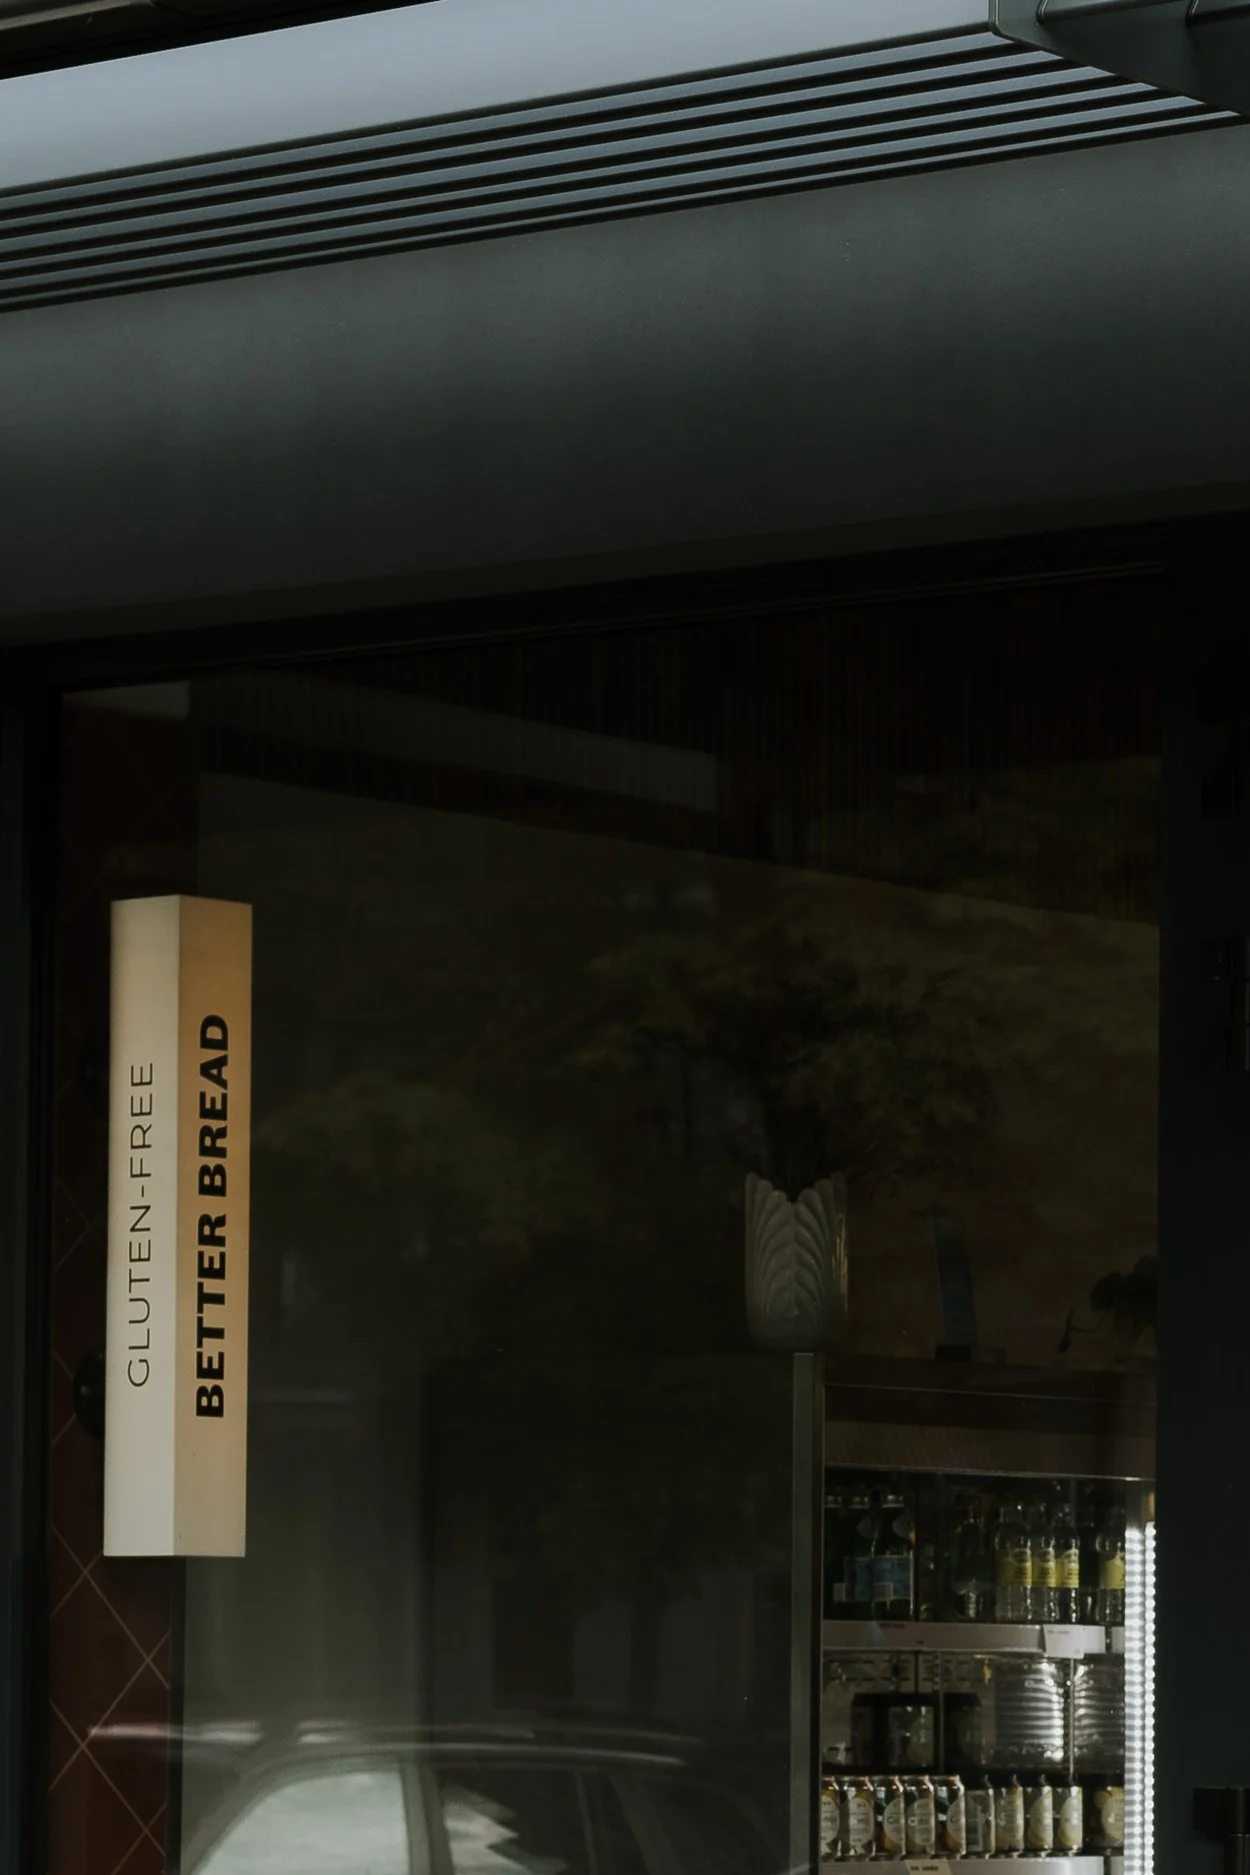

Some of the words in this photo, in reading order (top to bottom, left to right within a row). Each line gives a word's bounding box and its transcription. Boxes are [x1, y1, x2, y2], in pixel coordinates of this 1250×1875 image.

[198, 1013, 230, 1198] BREAD
[127, 1061, 153, 1388] GLUTEN-FREE
[195, 1212, 227, 1419] BETTER
